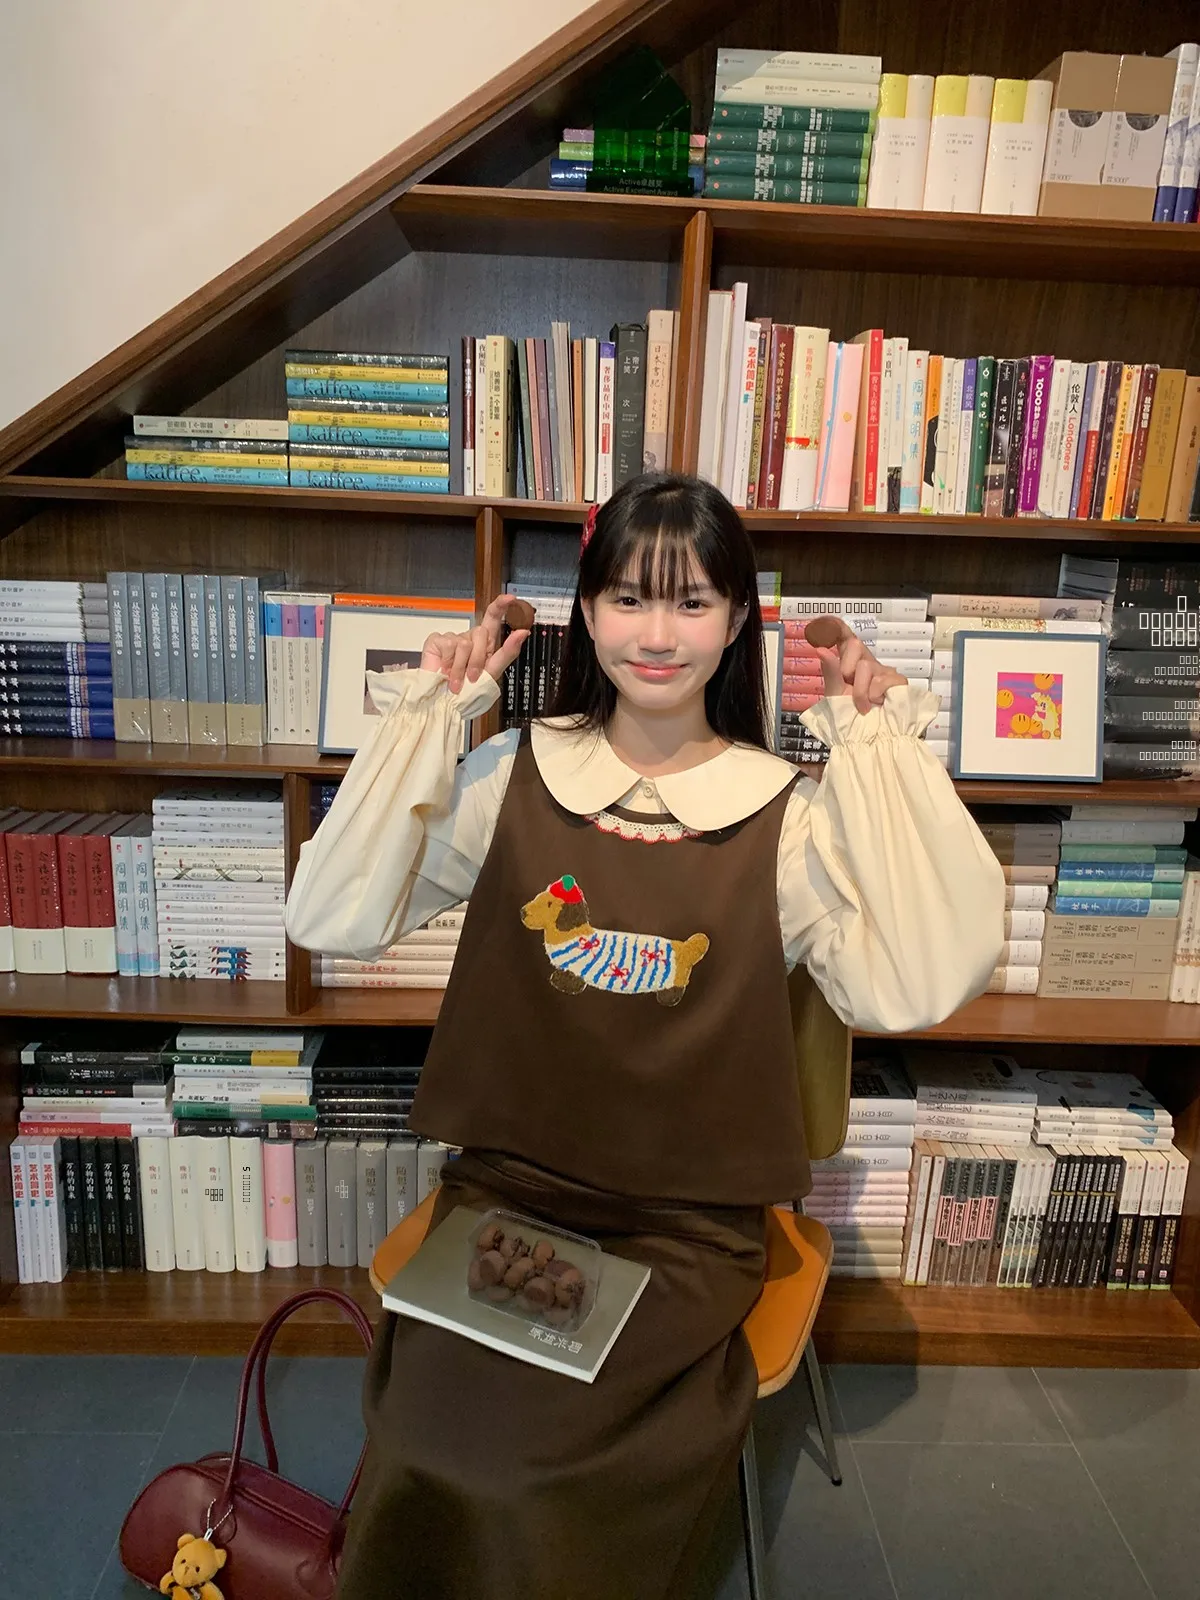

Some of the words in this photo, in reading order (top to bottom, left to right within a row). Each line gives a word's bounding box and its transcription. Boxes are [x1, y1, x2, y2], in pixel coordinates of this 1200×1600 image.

[624, 356, 640, 365] 上帝
[746, 346, 757, 392] 艺术简史
[304, 379, 360, 398] kaffee
[602, 366, 612, 420] 奢侈品在中国
[623, 400, 631, 408] 次
[965, 385, 974, 409] 北欧风
[1069, 384, 1080, 414] 伦敦人
[306, 424, 362, 444] kaffee
[1062, 416, 1076, 471] Londoners
[1116, 402, 1126, 450] 半小时漫画中国史
[144, 464, 200, 483] kaffee
[308, 470, 364, 490] kaffee
[113, 602, 122, 648] 从这里到永恒
[132, 602, 142, 648] 从这里到永恒
[151, 603, 162, 650] 从这里到永恒
[170, 603, 180, 648] 从这里到永恒
[190, 604, 200, 650] 从这里到永恒
[208, 604, 218, 651] 从这里到永恒
[228, 605, 238, 651] 从这里到永恒
[247, 607, 256, 652] 从这里到永恒
[13, 1164, 24, 1198] 艺术简史
[29, 1164, 39, 1198] 艺术简史
[44, 1164, 54, 1198] 艺术简史
[66, 1162, 76, 1200] 万物的由来
[85, 1162, 94, 1200] 万物的由来
[104, 1162, 114, 1200] 万物的由来
[122, 1164, 132, 1200] 万物的由来
